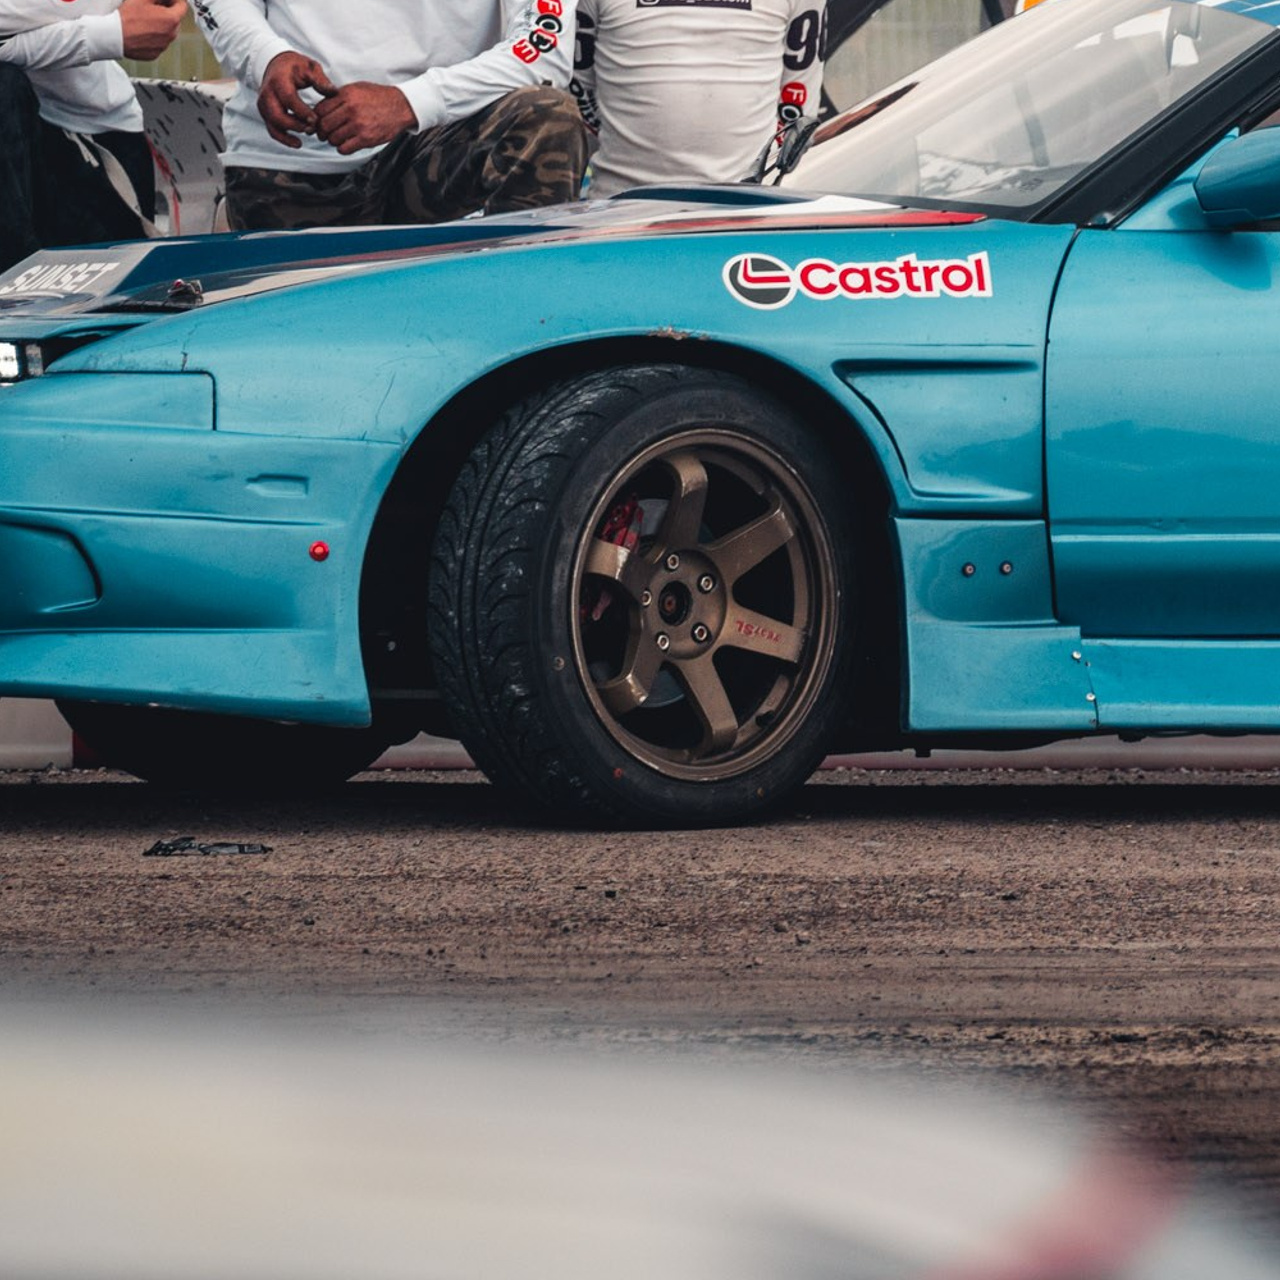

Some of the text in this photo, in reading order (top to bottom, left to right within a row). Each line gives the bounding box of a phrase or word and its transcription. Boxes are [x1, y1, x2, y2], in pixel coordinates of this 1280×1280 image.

[783, 8, 827, 70] 9
[0, 262, 120, 295] SUNSET
[800, 259, 986, 295] Castrol
